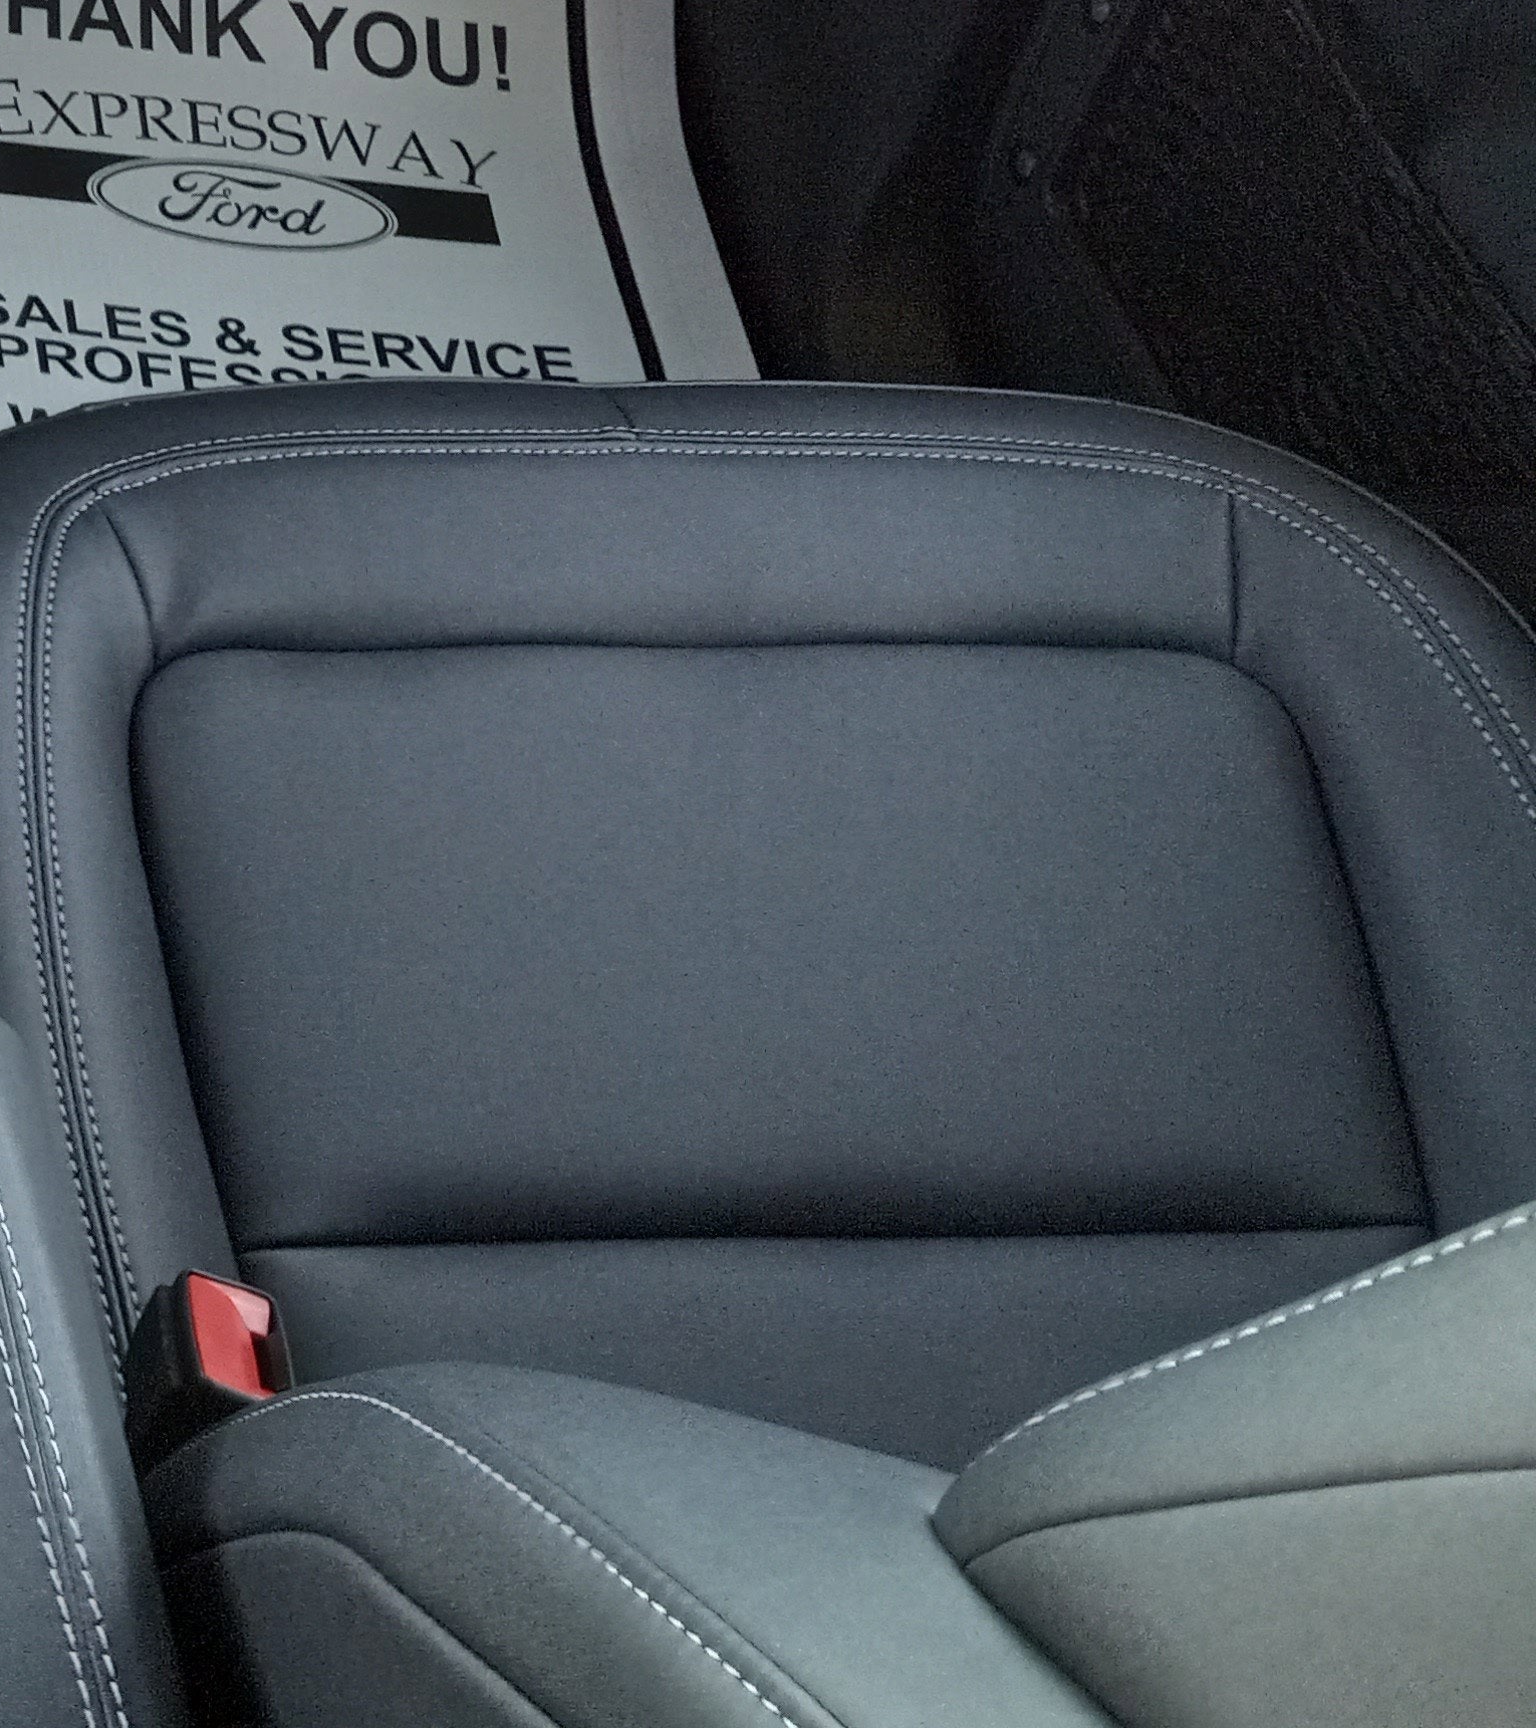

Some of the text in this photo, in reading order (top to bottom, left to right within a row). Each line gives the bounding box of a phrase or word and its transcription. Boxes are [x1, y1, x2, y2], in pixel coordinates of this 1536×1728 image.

[288, 0, 512, 92] YOU!
[157, 169, 328, 237] Ford
[215, 317, 262, 357] &
[281, 325, 580, 384] SERVICE
